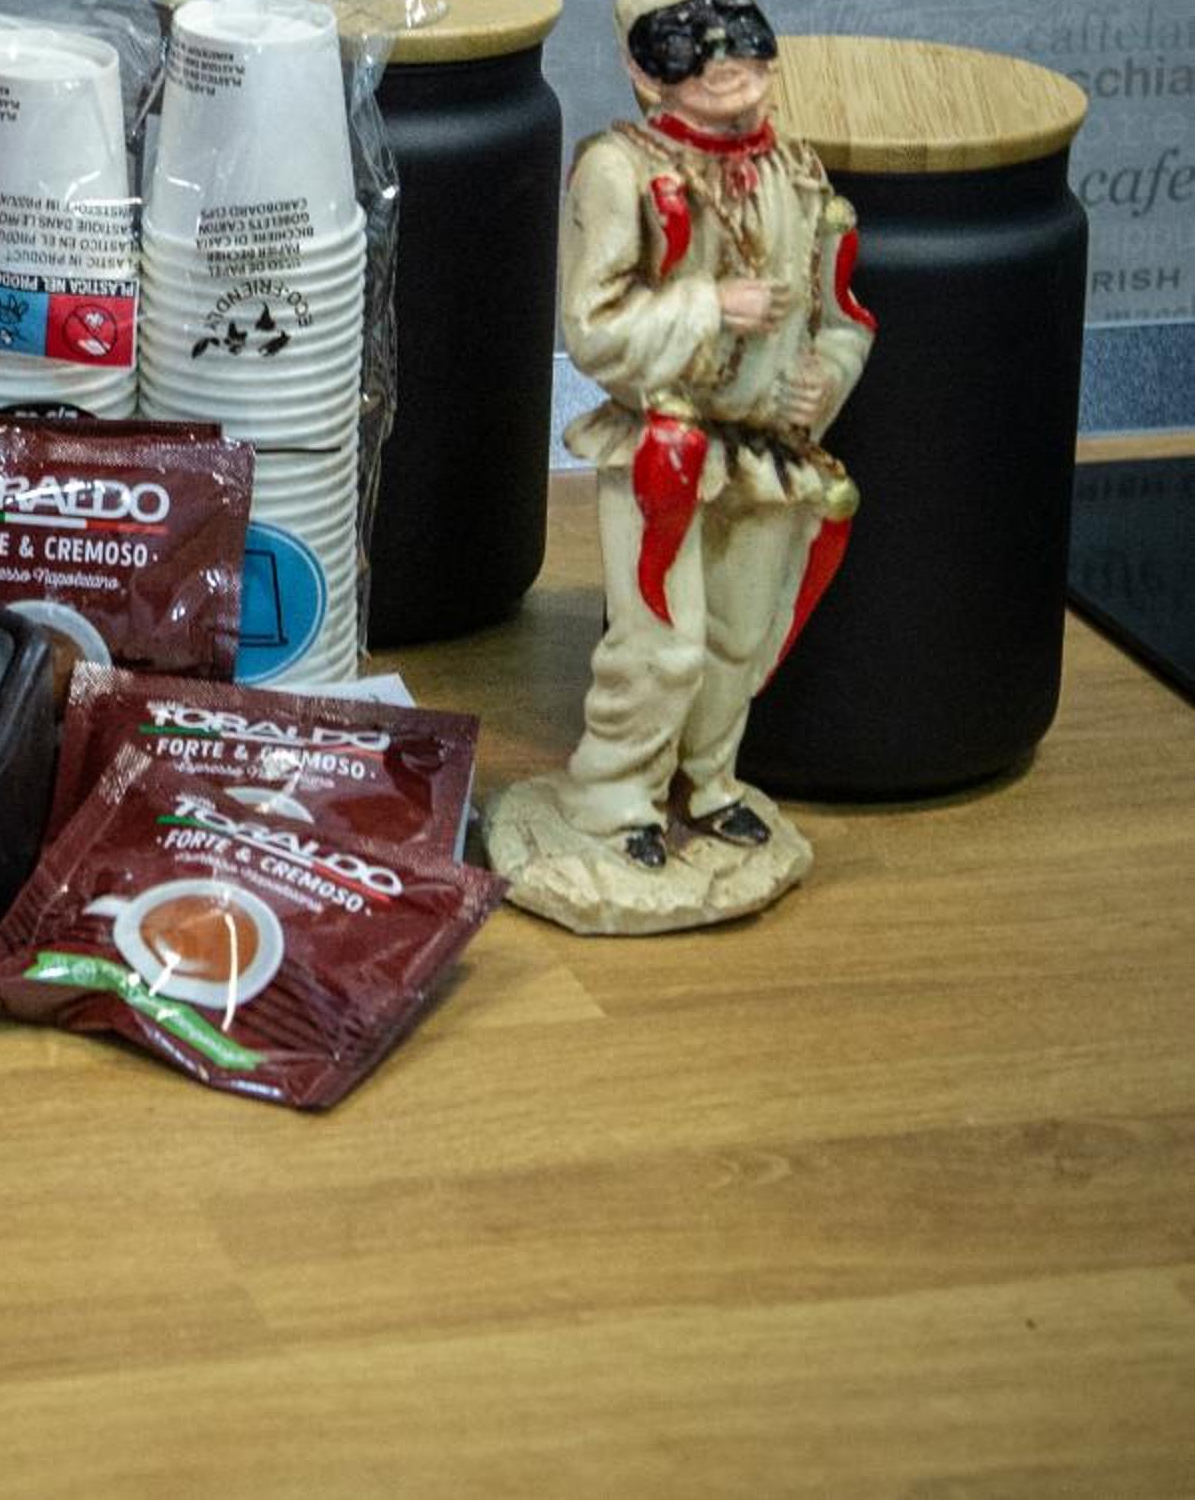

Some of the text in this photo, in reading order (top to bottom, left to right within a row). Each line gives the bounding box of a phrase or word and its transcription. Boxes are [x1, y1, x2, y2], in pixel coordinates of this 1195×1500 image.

[69, 278, 134, 297] PLASTICA
[19, 536, 35, 558] &
[44, 535, 149, 569] CREMOSO
[156, 737, 224, 761] FORTE
[234, 744, 248, 761] &
[235, 846, 252, 864] &
[260, 854, 365, 913] CREMOSO
